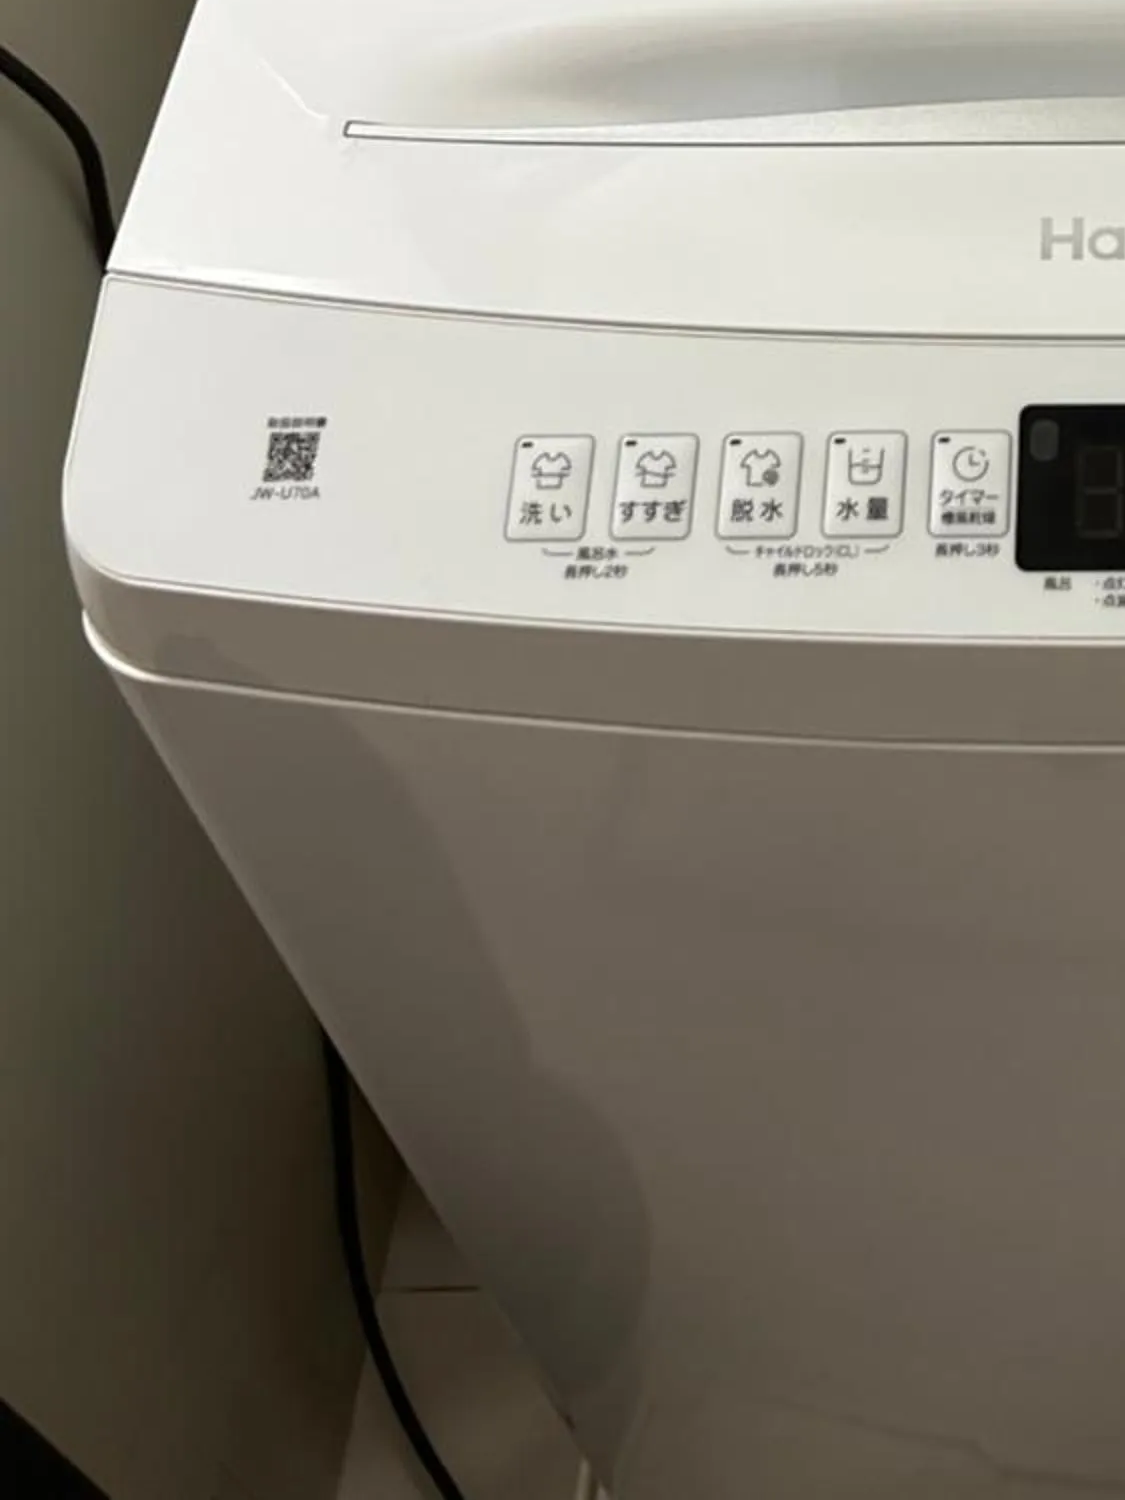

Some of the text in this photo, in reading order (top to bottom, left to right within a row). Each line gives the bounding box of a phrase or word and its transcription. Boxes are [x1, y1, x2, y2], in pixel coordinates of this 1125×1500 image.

[836, 497, 889, 521] 水量
[940, 489, 999, 506] タイマー
[519, 501, 573, 525] 洗い
[618, 499, 687, 523] すすぎ
[730, 498, 784, 522] 脱水
